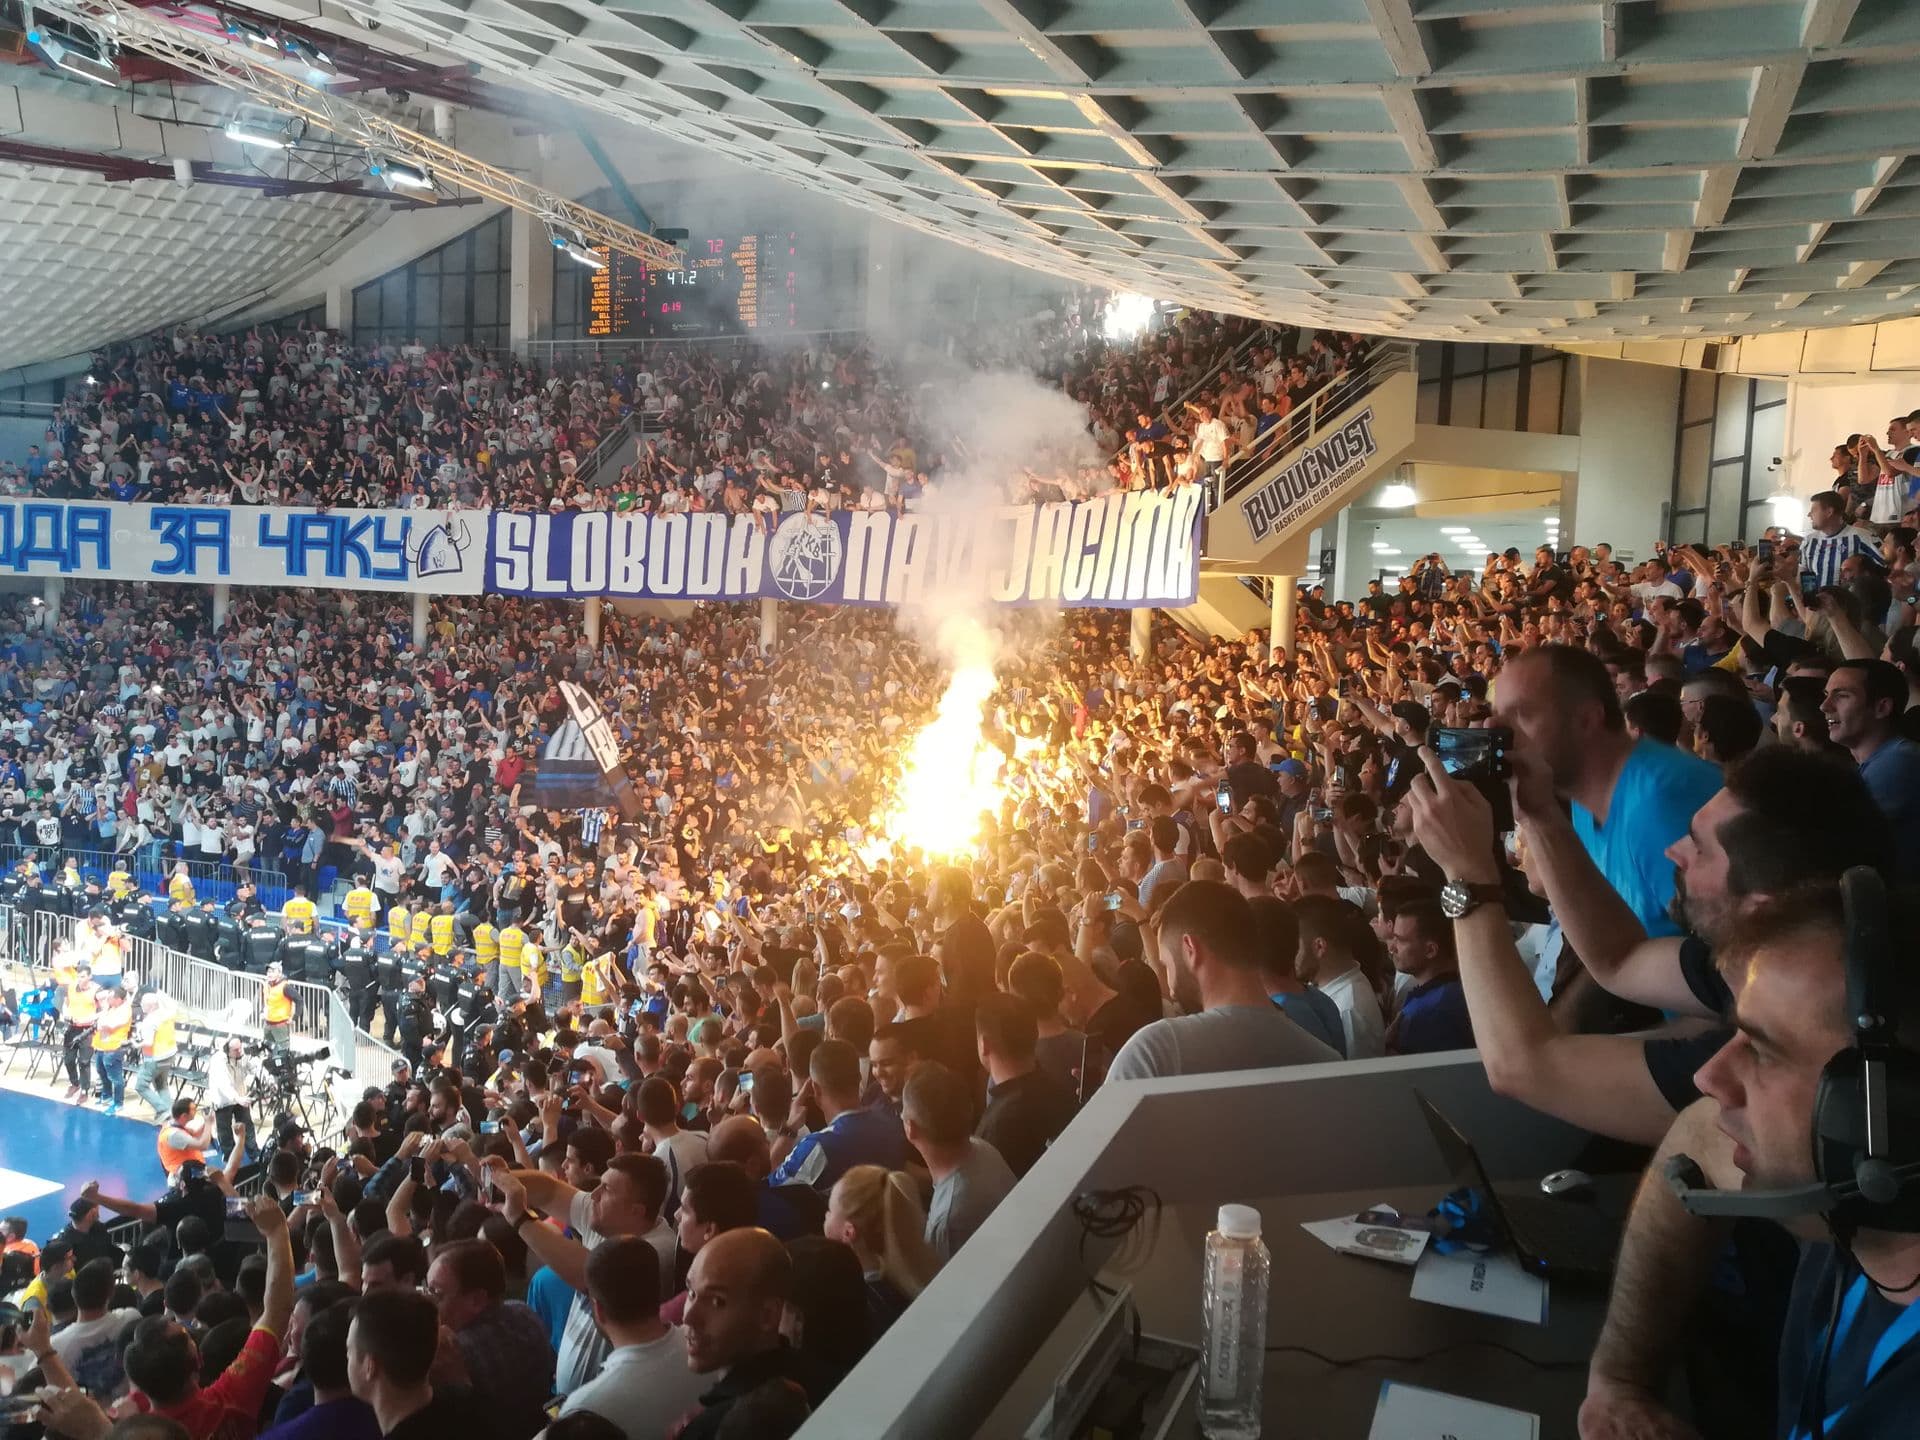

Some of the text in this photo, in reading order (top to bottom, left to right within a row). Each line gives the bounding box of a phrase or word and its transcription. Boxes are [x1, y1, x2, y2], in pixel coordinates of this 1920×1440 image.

[707, 240, 724, 254] 72
[650, 273, 657, 286] 5
[667, 270, 697, 285] 47.2
[1241, 407, 1376, 541] BUDUĆNOST
[1274, 457, 1367, 534] BASKETBALL CLUB PODGORICA
[150, 507, 231, 575] ЗА
[259, 513, 412, 581] ЧАКУ
[496, 511, 767, 595] SLOBODA
[1323, 551, 1333, 567] 4
